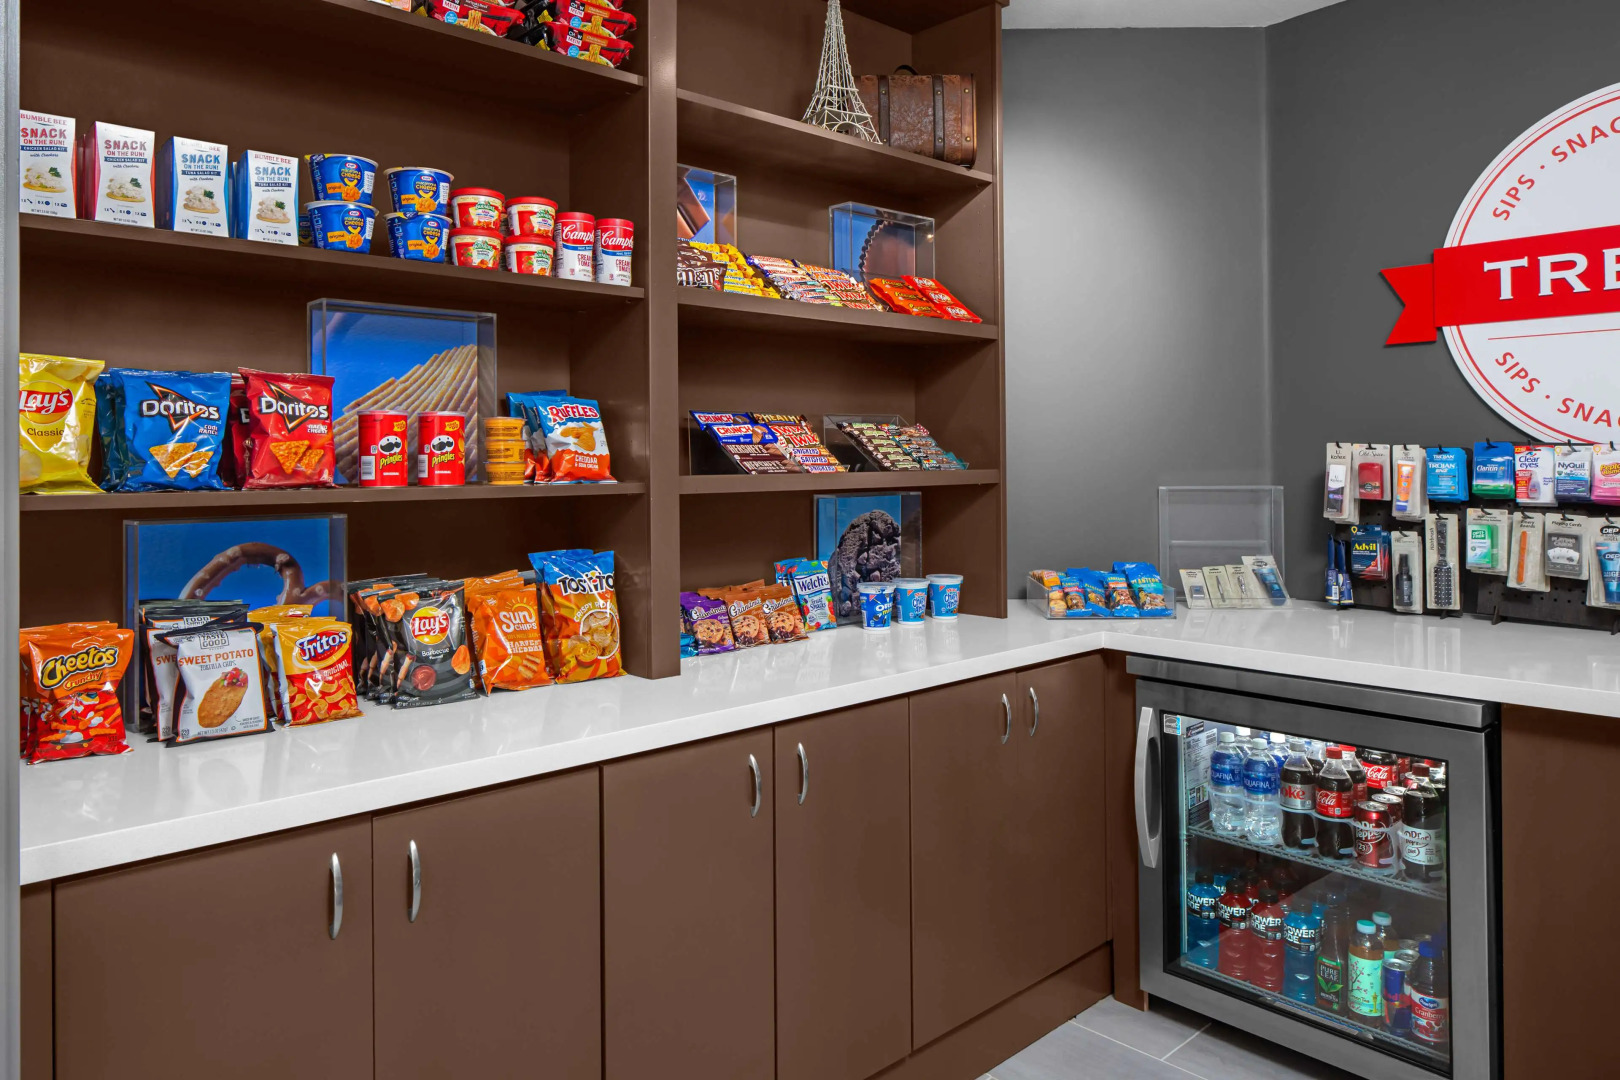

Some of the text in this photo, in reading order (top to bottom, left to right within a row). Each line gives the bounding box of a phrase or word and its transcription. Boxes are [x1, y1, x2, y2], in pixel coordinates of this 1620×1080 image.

[20, 127, 67, 140] SNACK
[104, 139, 147, 152] SNACK
[181, 153, 221, 165] SNACK
[254, 166, 291, 177] SNACK
[1492, 174, 1536, 221] SIPS
[1494, 351, 1620, 428] SIPS SNA
[142, 400, 220, 419] Doritos
[261, 397, 329, 419] Doritos
[548, 404, 600, 424] RUFFLES
[697, 414, 734, 423] CRUNCH
[27, 426, 65, 437] Classic
[716, 425, 753, 435] CRUNCH
[785, 433, 819, 448] TWIX
[379, 452, 403, 470] Pringles
[431, 452, 455, 468] Pringles
[574, 454, 598, 465] CHEDDAR
[1518, 455, 1540, 463] Clear
[1519, 462, 1539, 470] eyes
[1557, 462, 1585, 470] NyQuil
[1352, 542, 1377, 551] Advil
[797, 575, 830, 592] Welch's
[413, 614, 448, 636] Lay's
[499, 610, 536, 633] Sun
[514, 622, 537, 631] CHIPS
[200, 631, 226, 641] TASTE
[202, 638, 227, 648] GOOD
[296, 631, 347, 661] Fritos
[178, 648, 254, 667] SWEET POTATO
[421, 647, 450, 658] Barbecue
[41, 645, 119, 687] Cheetos
[63, 671, 102, 690] Crunchy
[1320, 964, 1339, 976] PURE
[1320, 971, 1339, 982] LEAF
